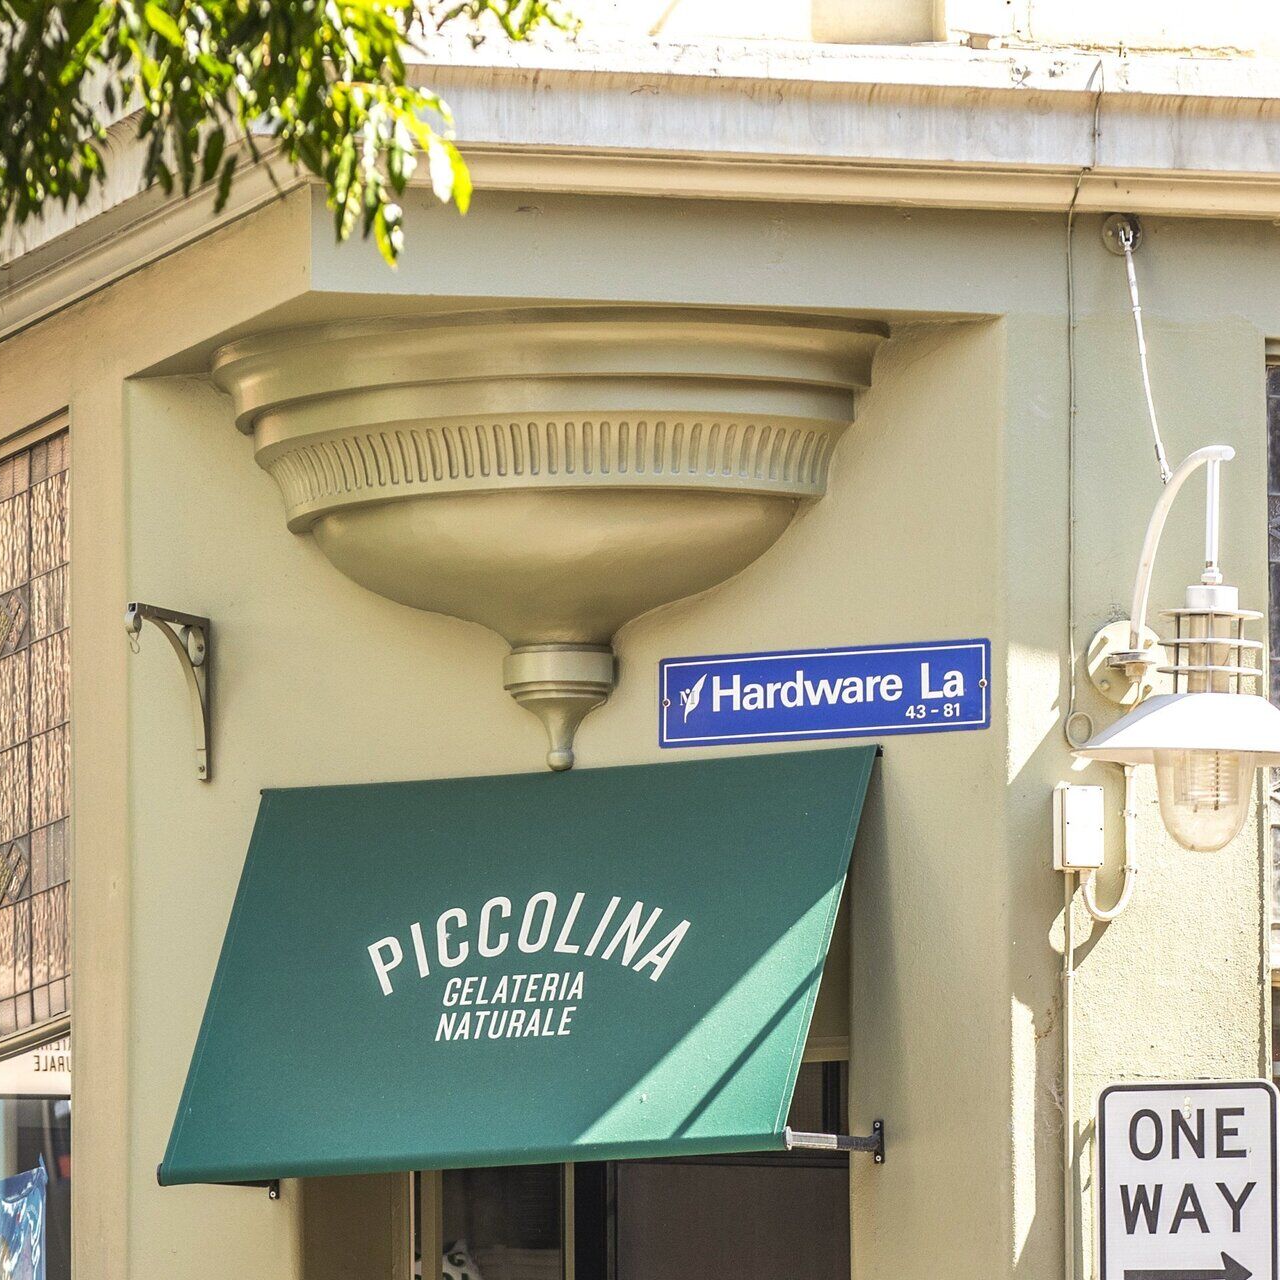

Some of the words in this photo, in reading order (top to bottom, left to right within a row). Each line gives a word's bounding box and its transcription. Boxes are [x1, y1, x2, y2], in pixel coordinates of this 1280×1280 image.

[712, 669, 903, 712] Hardware
[920, 662, 964, 699] La
[905, 705, 926, 719] 43
[943, 703, 961, 717] 81
[367, 891, 692, 996] PICCOLINA
[443, 972, 584, 1007] GELATERIA
[434, 1006, 577, 1041] NATURALE
[1129, 1107, 1247, 1161] ONE
[1119, 1181, 1257, 1234] WAY
